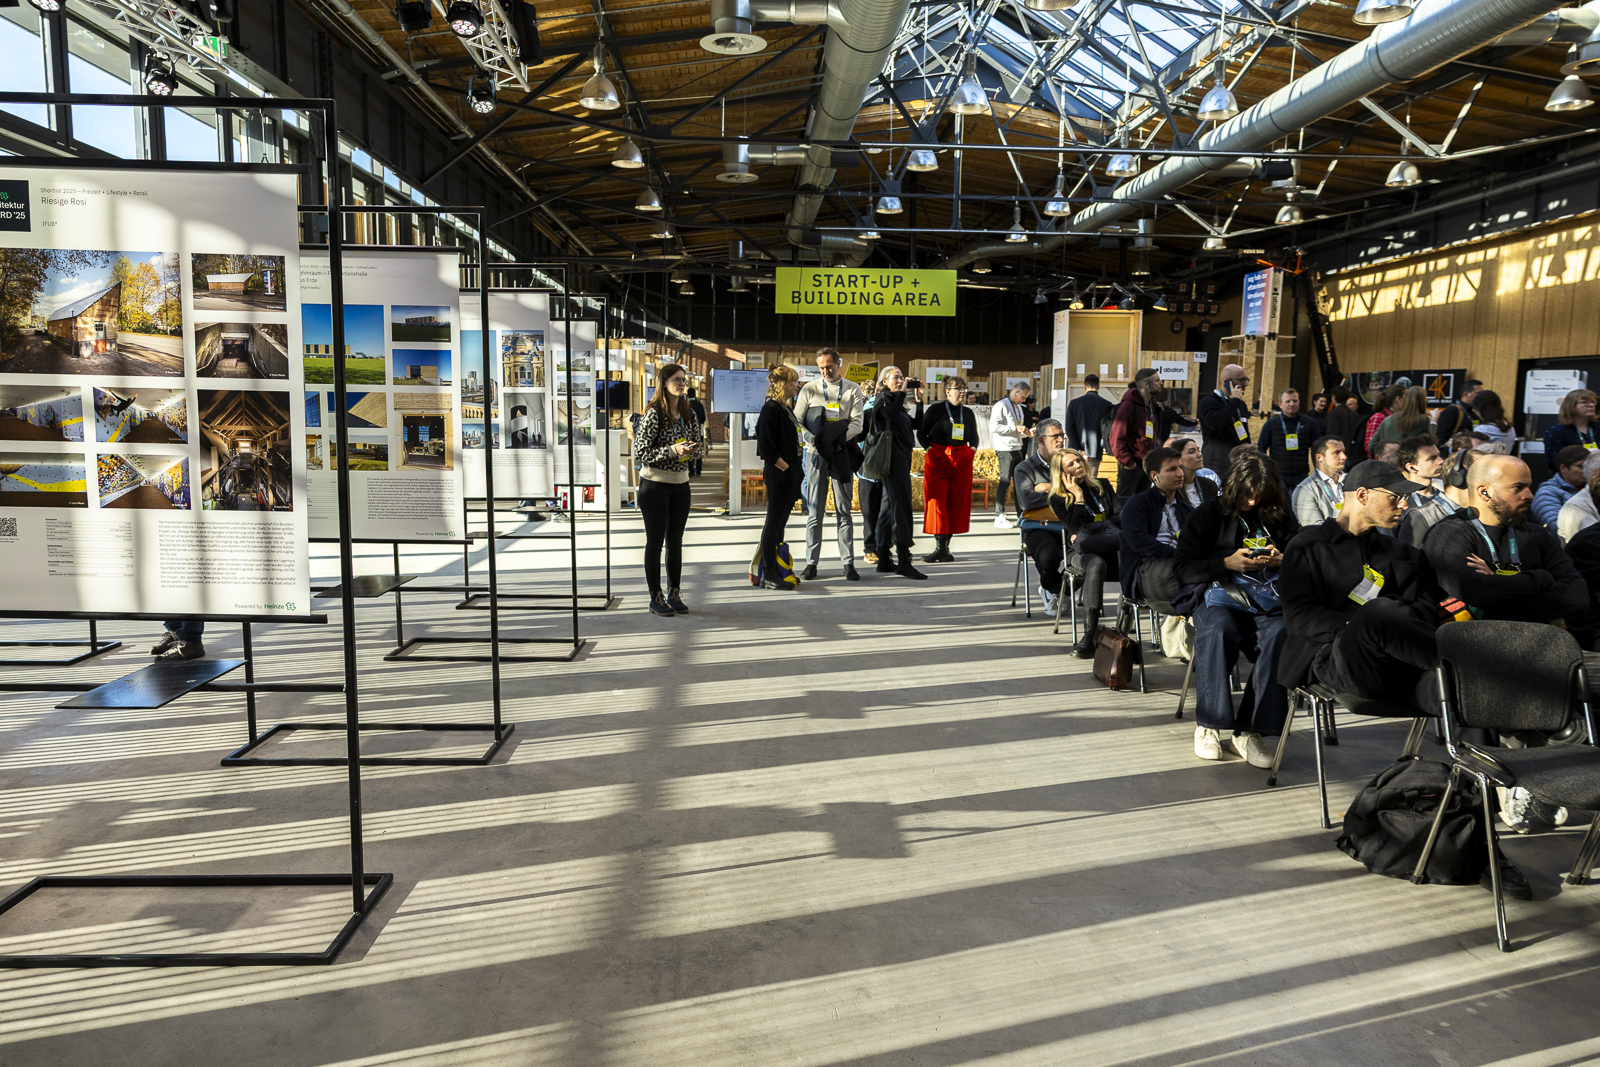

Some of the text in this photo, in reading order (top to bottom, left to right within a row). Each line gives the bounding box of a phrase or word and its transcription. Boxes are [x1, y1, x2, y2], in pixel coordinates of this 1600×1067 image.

[41, 197, 69, 206] Riesige
[812, 274, 920, 288] START-UP +
[791, 291, 941, 307] BUILDING AREA
